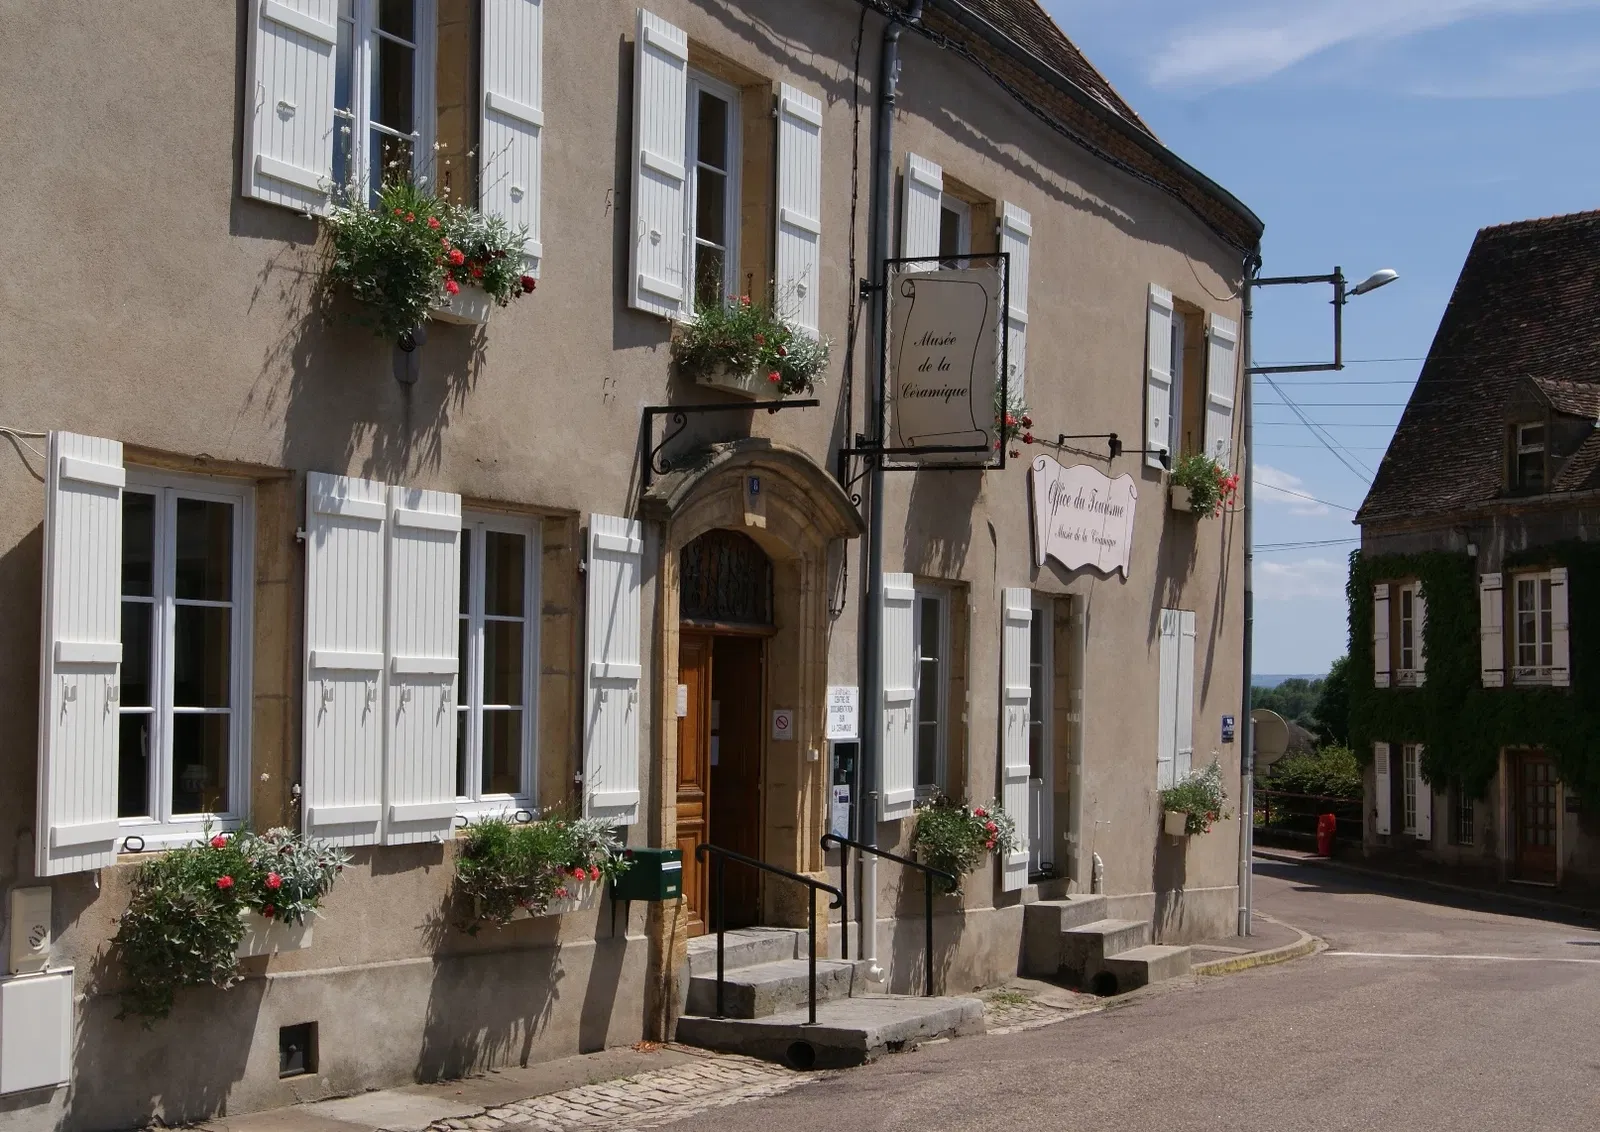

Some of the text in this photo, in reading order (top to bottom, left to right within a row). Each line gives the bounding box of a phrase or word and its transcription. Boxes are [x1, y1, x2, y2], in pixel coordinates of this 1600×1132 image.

[913, 330, 957, 346] Musée
[918, 355, 951, 373] de la
[901, 382, 968, 404] Céramique
[1048, 479, 1124, 518] Office du Tourisme
[1074, 527, 1081, 541] de
